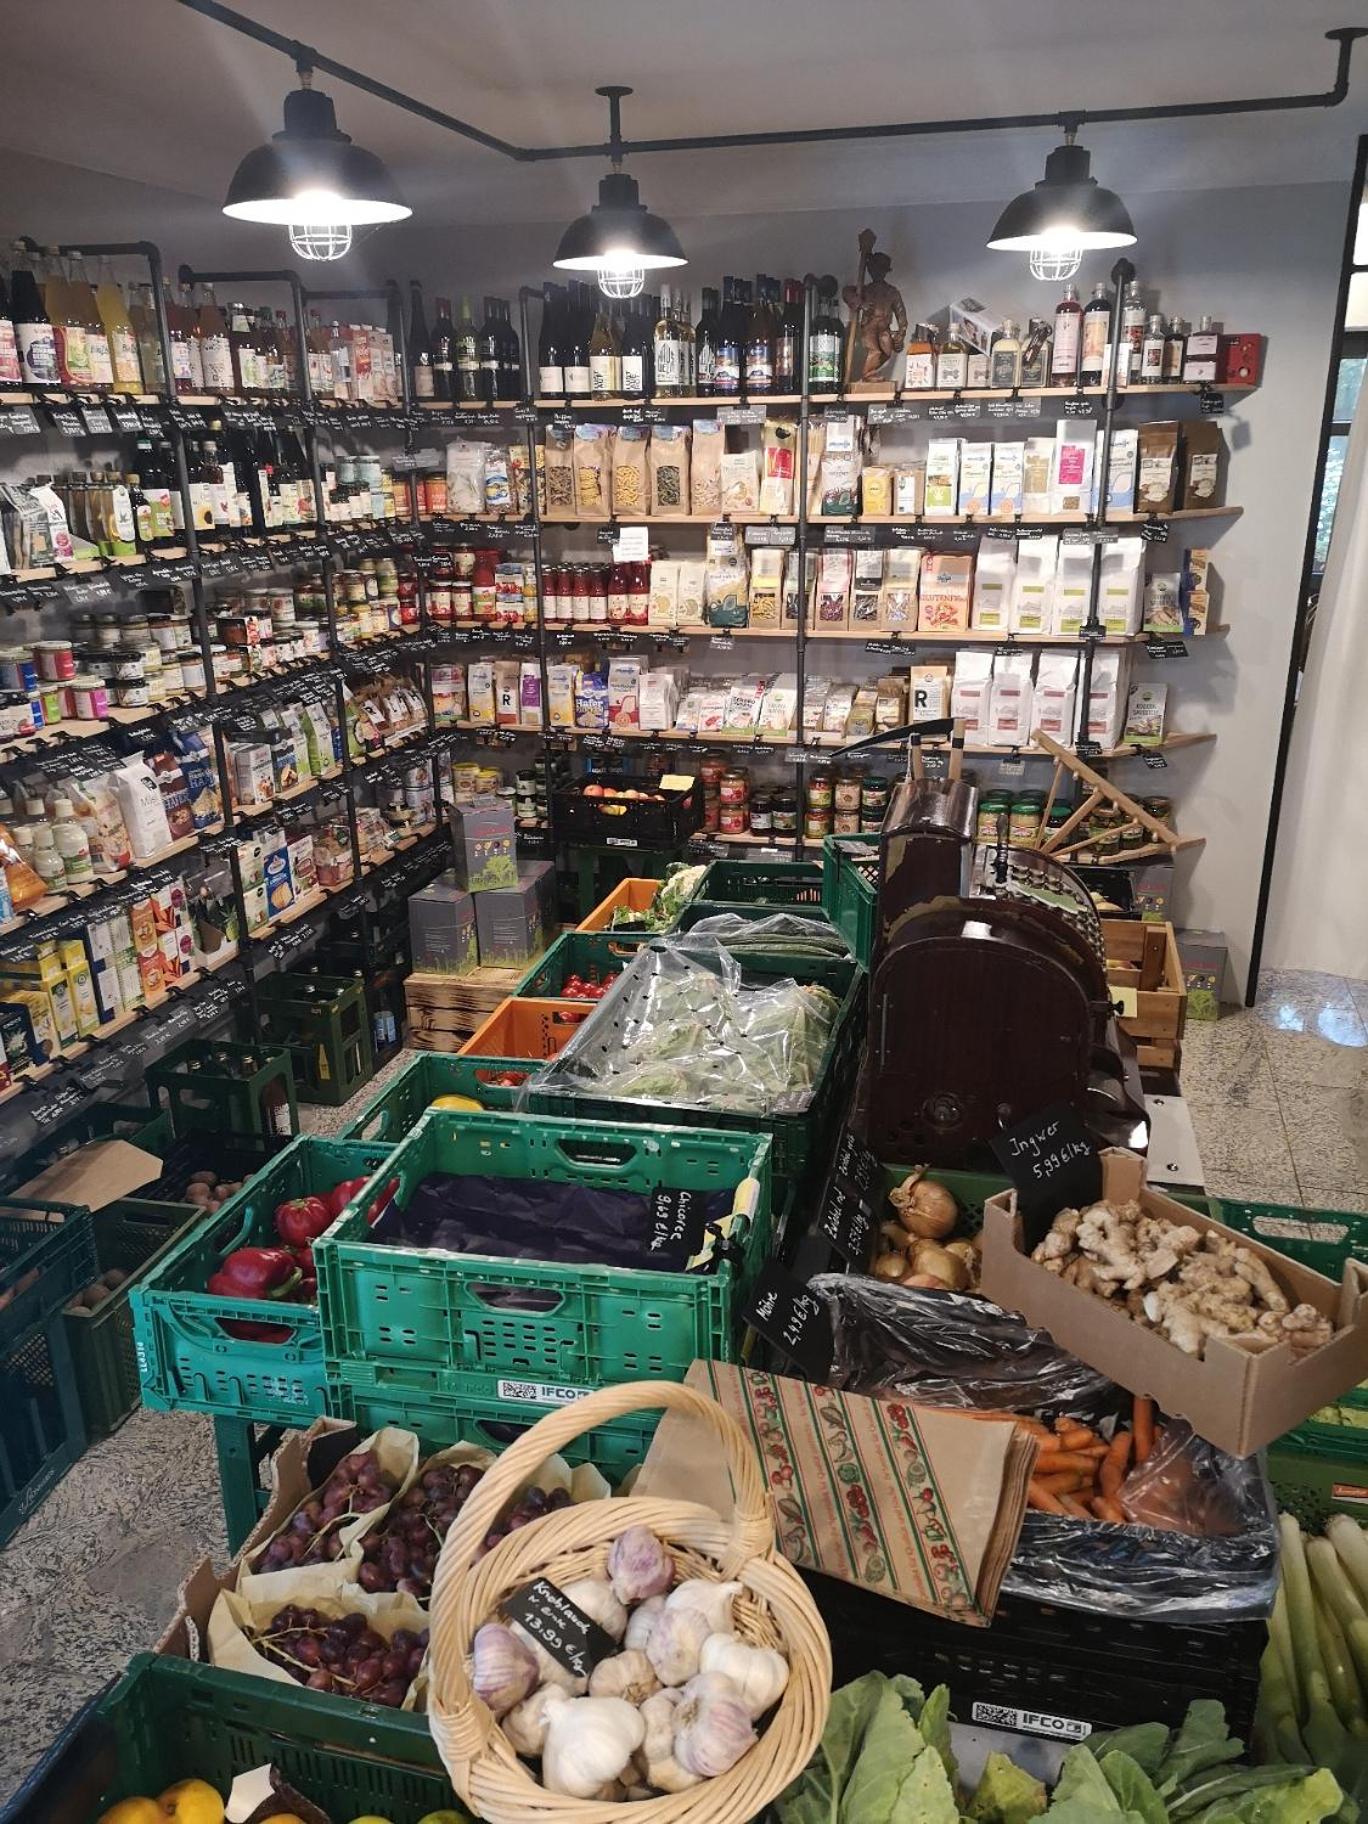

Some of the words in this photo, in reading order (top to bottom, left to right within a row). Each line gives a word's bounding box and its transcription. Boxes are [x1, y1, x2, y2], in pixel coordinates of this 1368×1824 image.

[914, 690, 928, 708] R
[1008, 1121, 1060, 1157] Ingwer
[756, 1291, 778, 1321] Möhre
[541, 1386, 576, 1400] IFCO
[533, 1581, 591, 1635] Knoblauch
[1023, 1713, 1064, 1729] IFCO
